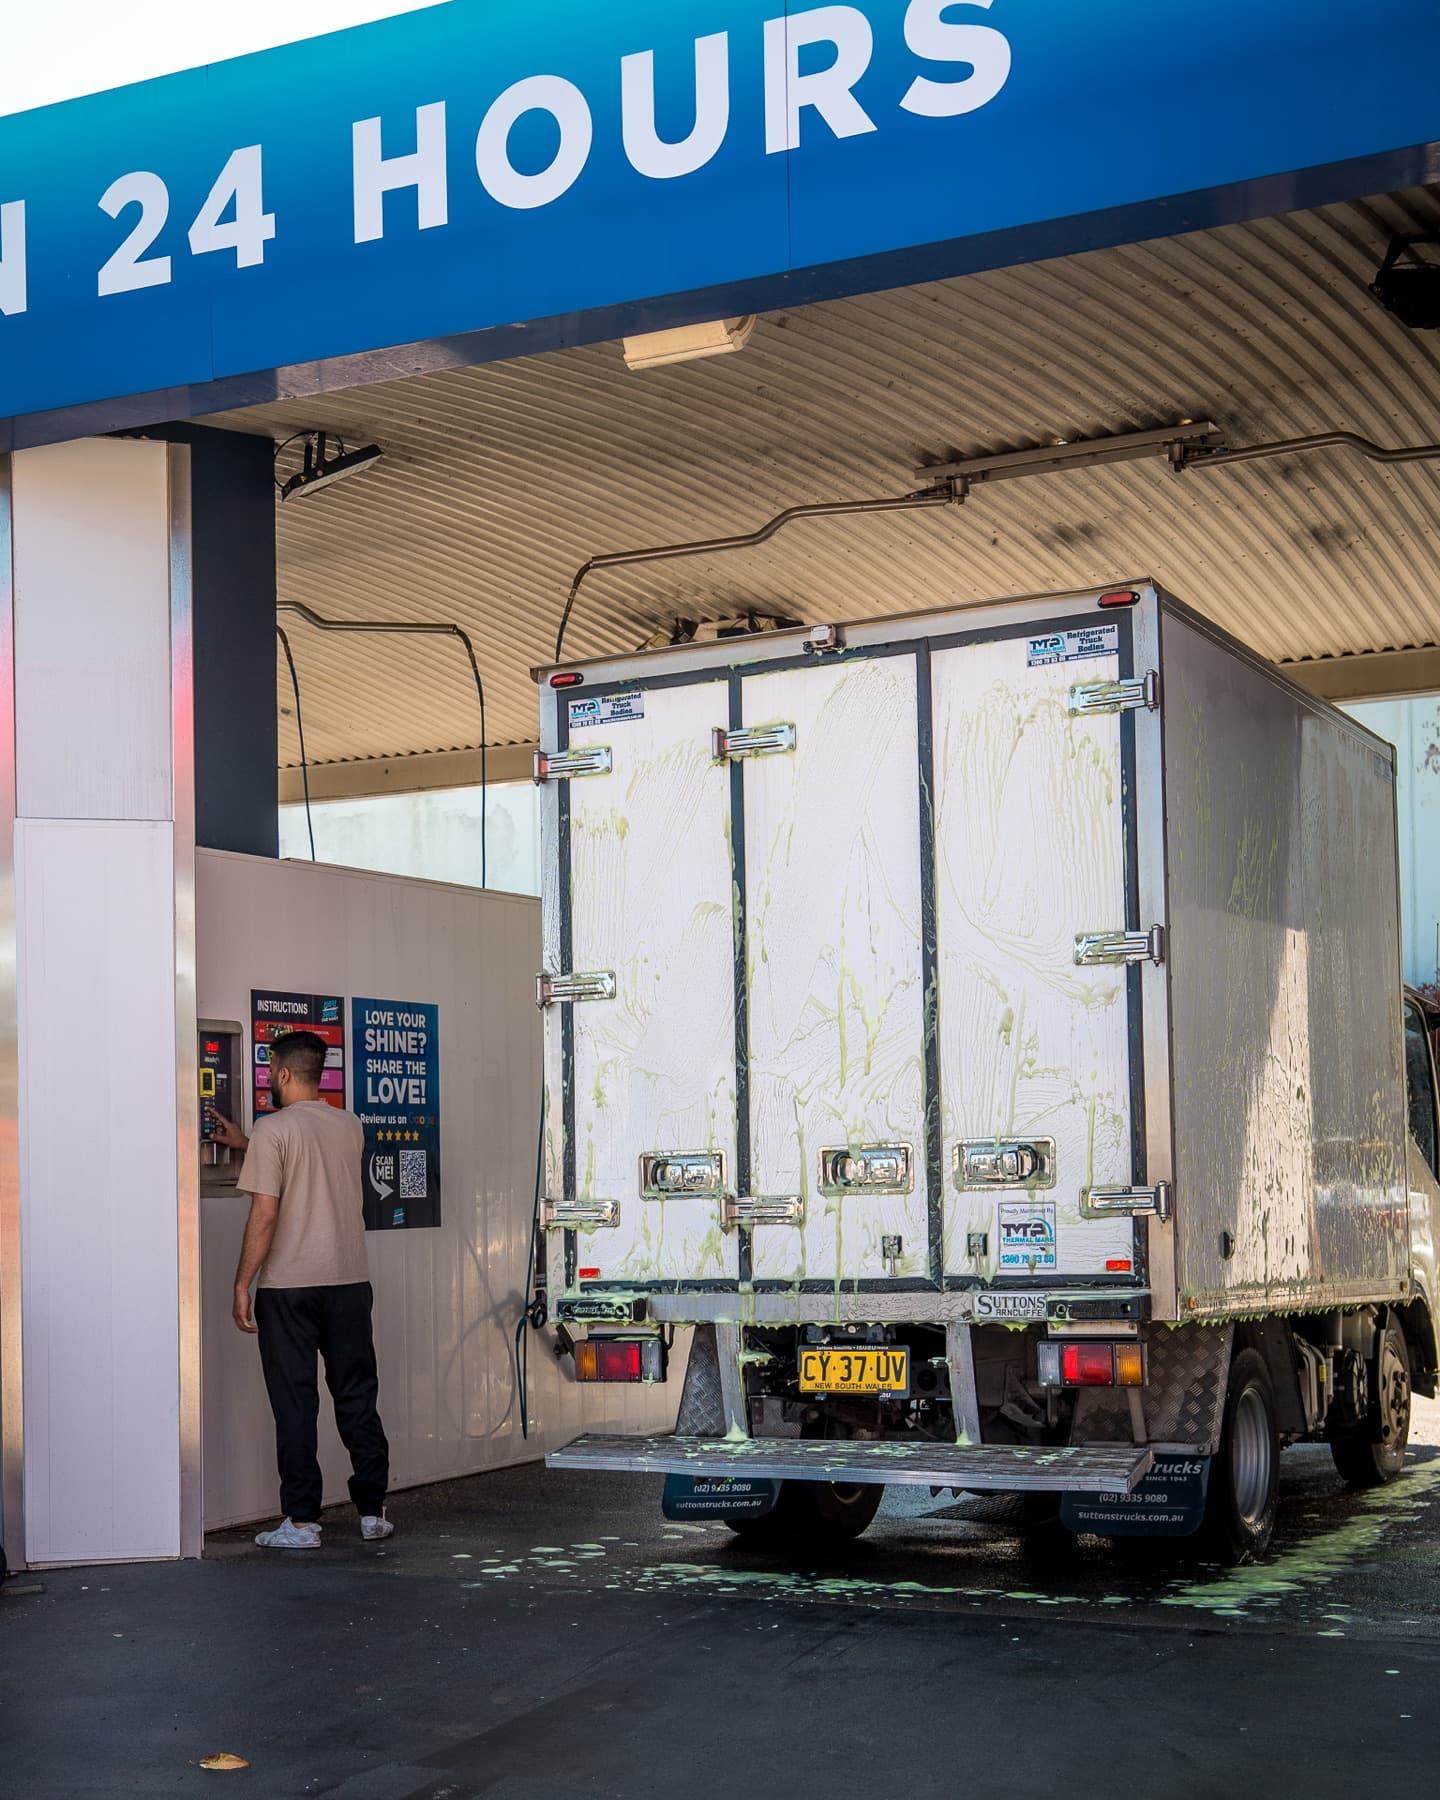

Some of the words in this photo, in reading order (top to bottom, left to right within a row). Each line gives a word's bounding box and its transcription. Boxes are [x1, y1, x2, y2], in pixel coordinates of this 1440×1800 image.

[98, 144, 276, 297] 24
[352, 0, 1012, 244] HOURS
[1066, 625, 1115, 639] Refrigerated
[1080, 636, 1103, 644] Truck
[1078, 644, 1104, 652] Bodies
[612, 701, 631, 709] Truck
[257, 999, 309, 1015] INSTRUCTIONS
[365, 1010, 394, 1026] LOVE
[397, 1012, 426, 1028] YOUR
[365, 1028, 427, 1054] SHINE?
[366, 1058, 403, 1074] SHARE
[405, 1061, 426, 1075] THE
[367, 1077, 426, 1104] LOVE!
[360, 1113, 387, 1125] Review
[388, 1116, 397, 1124] us
[397, 1116, 407, 1124] on
[375, 1155, 394, 1166] SCAN
[376, 1166, 394, 1180] ME!
[978, 1295, 1046, 1315] SUTTONS
[996, 1309, 1043, 1317] ARNCLIFFE
[1152, 1461, 1202, 1474] rucks
[1100, 1493, 1117, 1503] (02)
[1120, 1493, 1142, 1503] 9335
[1144, 1493, 1168, 1503] 9080
[1078, 1511, 1184, 1522] suttonstrucks.com.au
